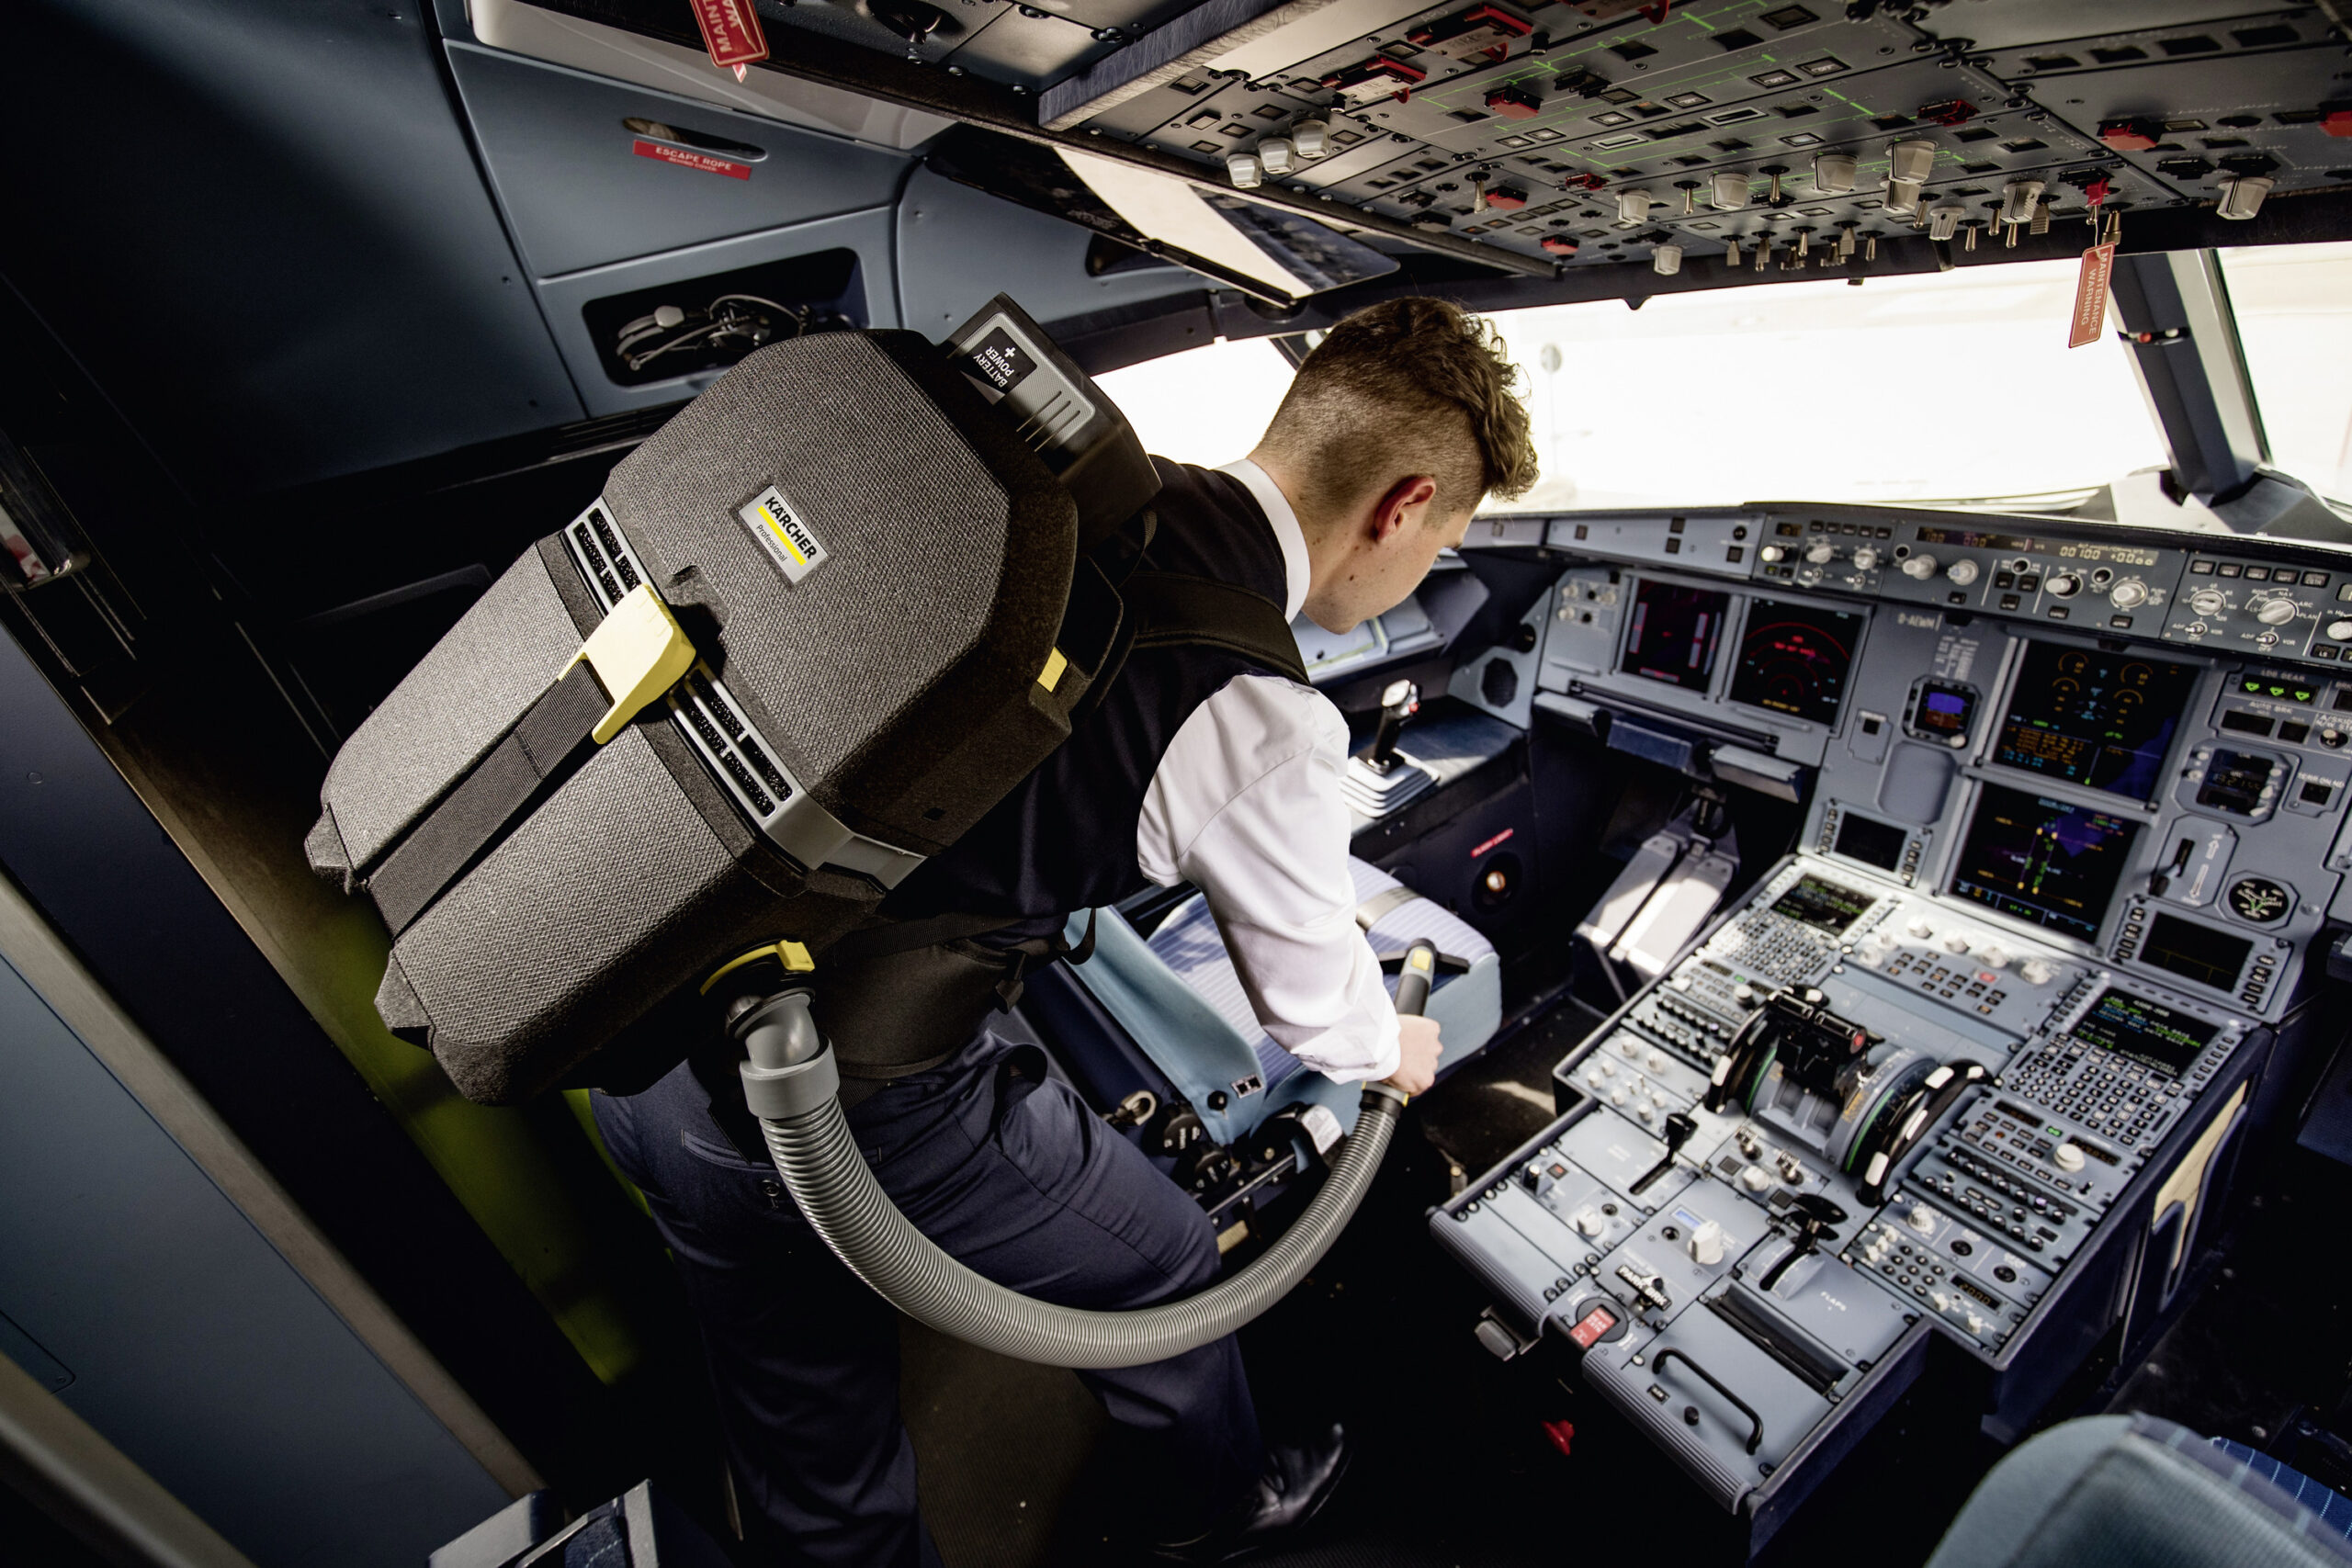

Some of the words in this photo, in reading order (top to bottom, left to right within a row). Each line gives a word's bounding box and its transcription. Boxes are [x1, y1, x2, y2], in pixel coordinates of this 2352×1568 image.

[655, 146, 700, 163] ESCAPE
[702, 157, 732, 171] ROPE
[2081, 268, 2098, 326] WARNING
[2088, 252, 2109, 335] MAINTENANCE
[973, 353, 1008, 388] BATTERY
[985, 345, 1014, 377] POWER
[756, 525, 787, 562] Professional
[764, 496, 817, 559] KÄRCHER
[2280, 671, 2305, 682] GEAR
[2249, 701, 2272, 711] AUTO
[2274, 705, 2293, 715] BRK
[1781, 1152, 1796, 1165] ENG
[1618, 1266, 1647, 1289] PARK
[1645, 1286, 1668, 1306] BRK
[1820, 1291, 1847, 1312] FLAPS
